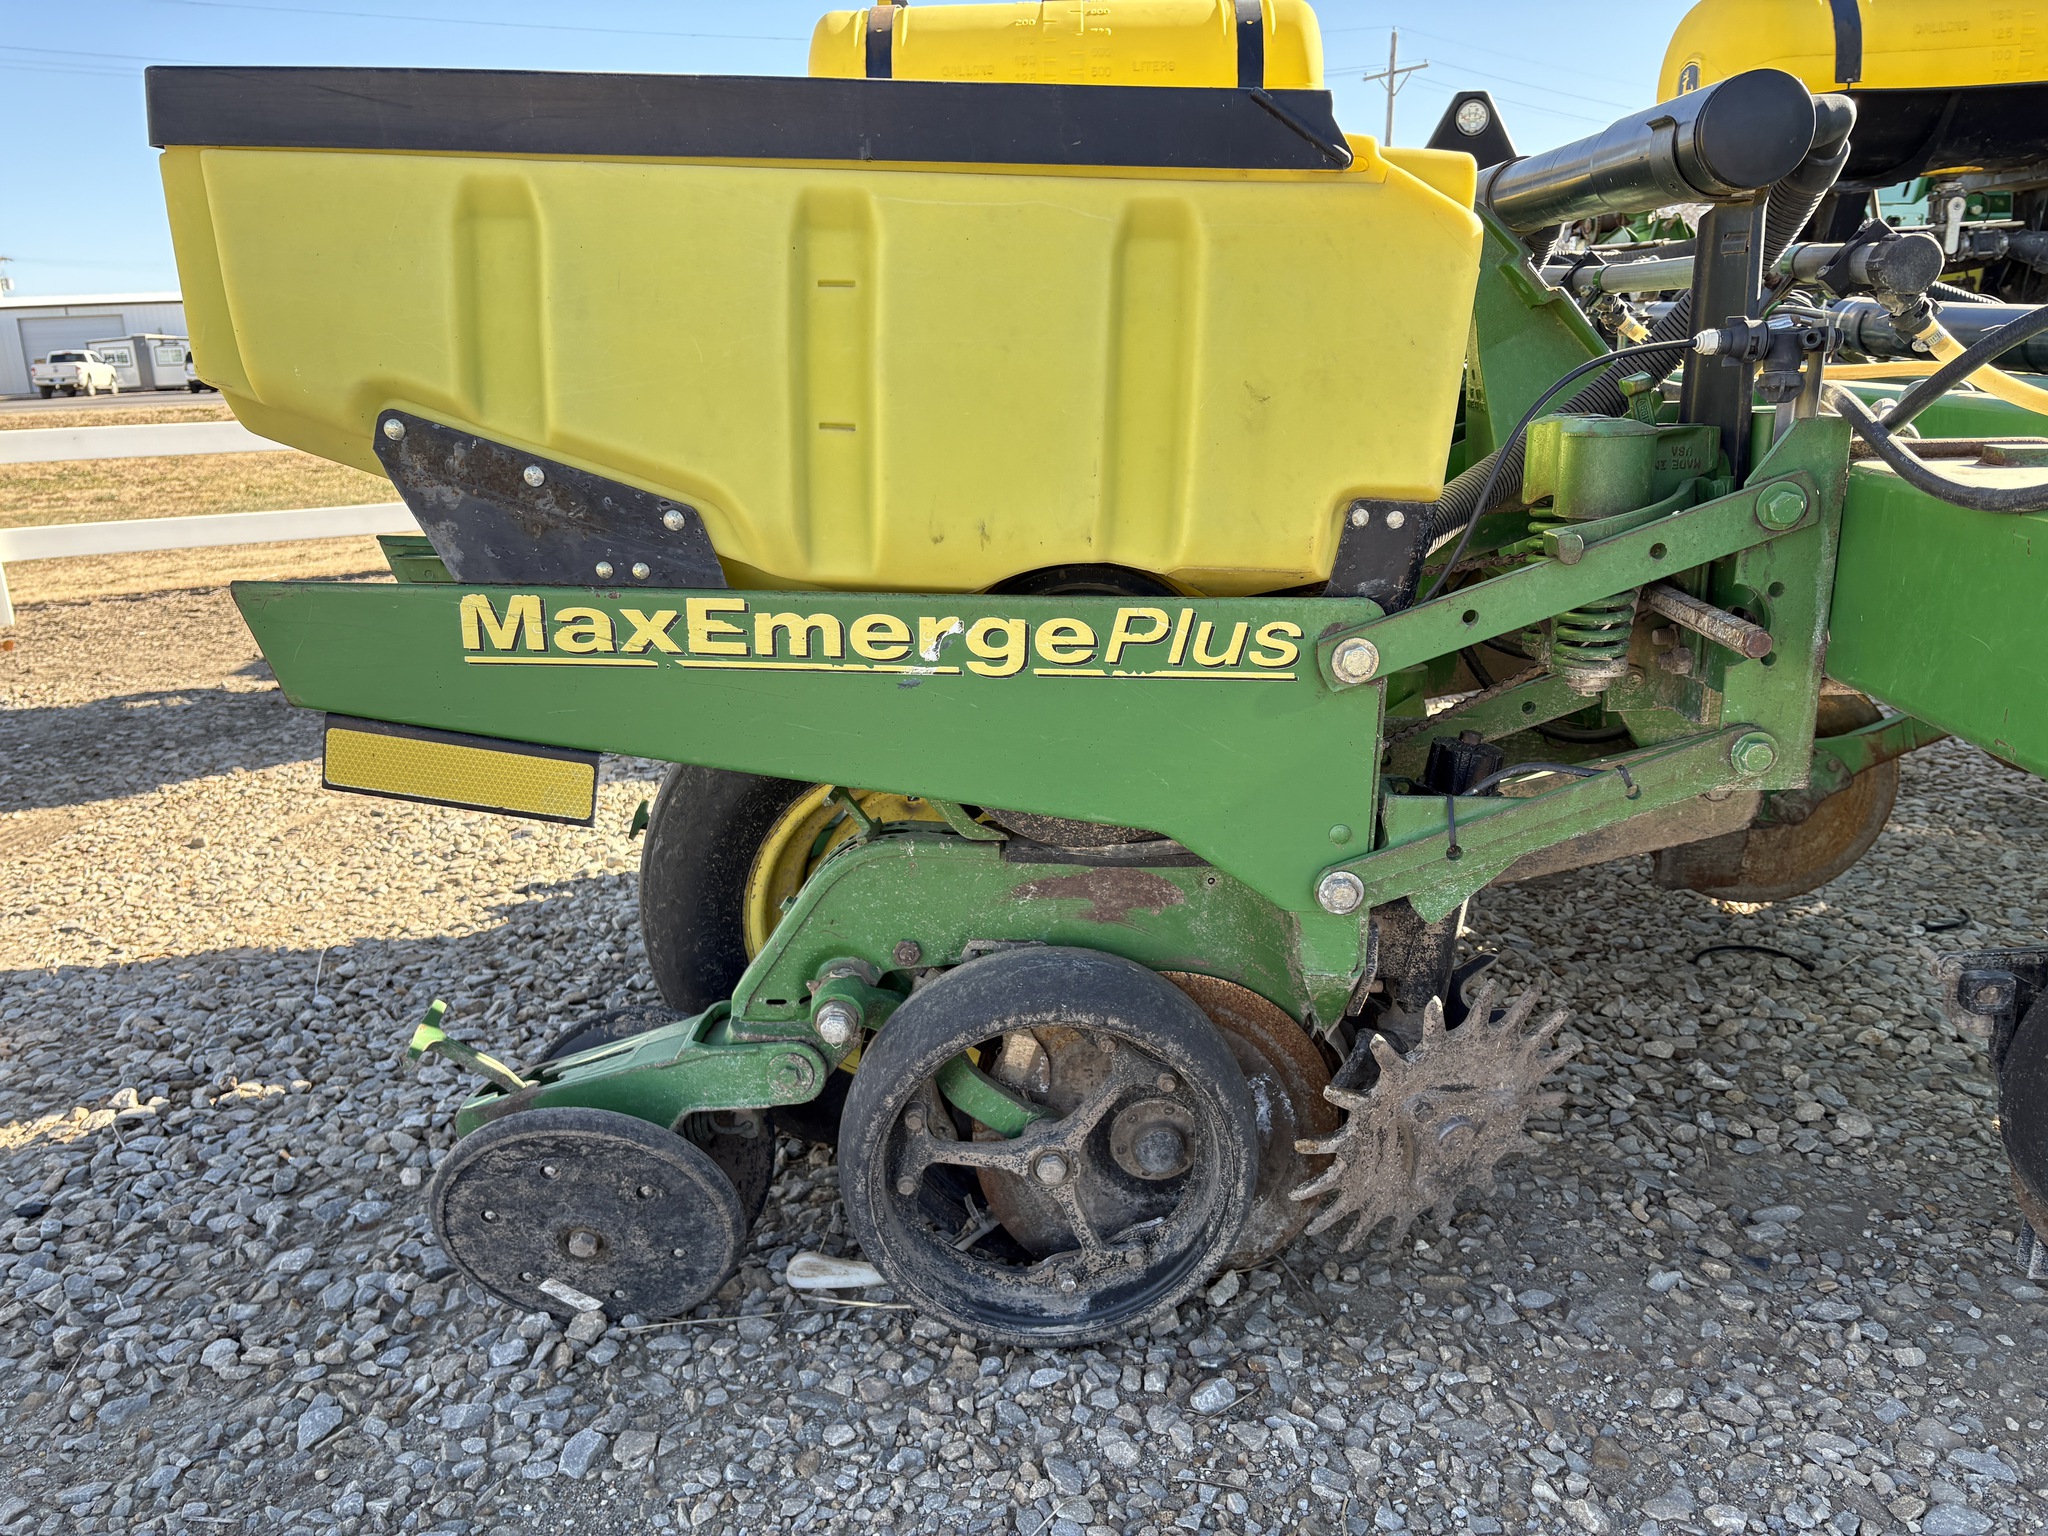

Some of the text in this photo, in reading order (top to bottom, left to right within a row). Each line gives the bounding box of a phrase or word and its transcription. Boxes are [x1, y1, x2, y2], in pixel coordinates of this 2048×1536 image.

[1015, 18, 1037, 26] 200
[1991, 27, 2014, 39] 125
[1991, 49, 2013, 61] 100
[1090, 66, 1112, 78] 500
[1132, 60, 1176, 73] LITERS
[1670, 446, 1693, 457] USA
[1671, 458, 1703, 471] MADE
